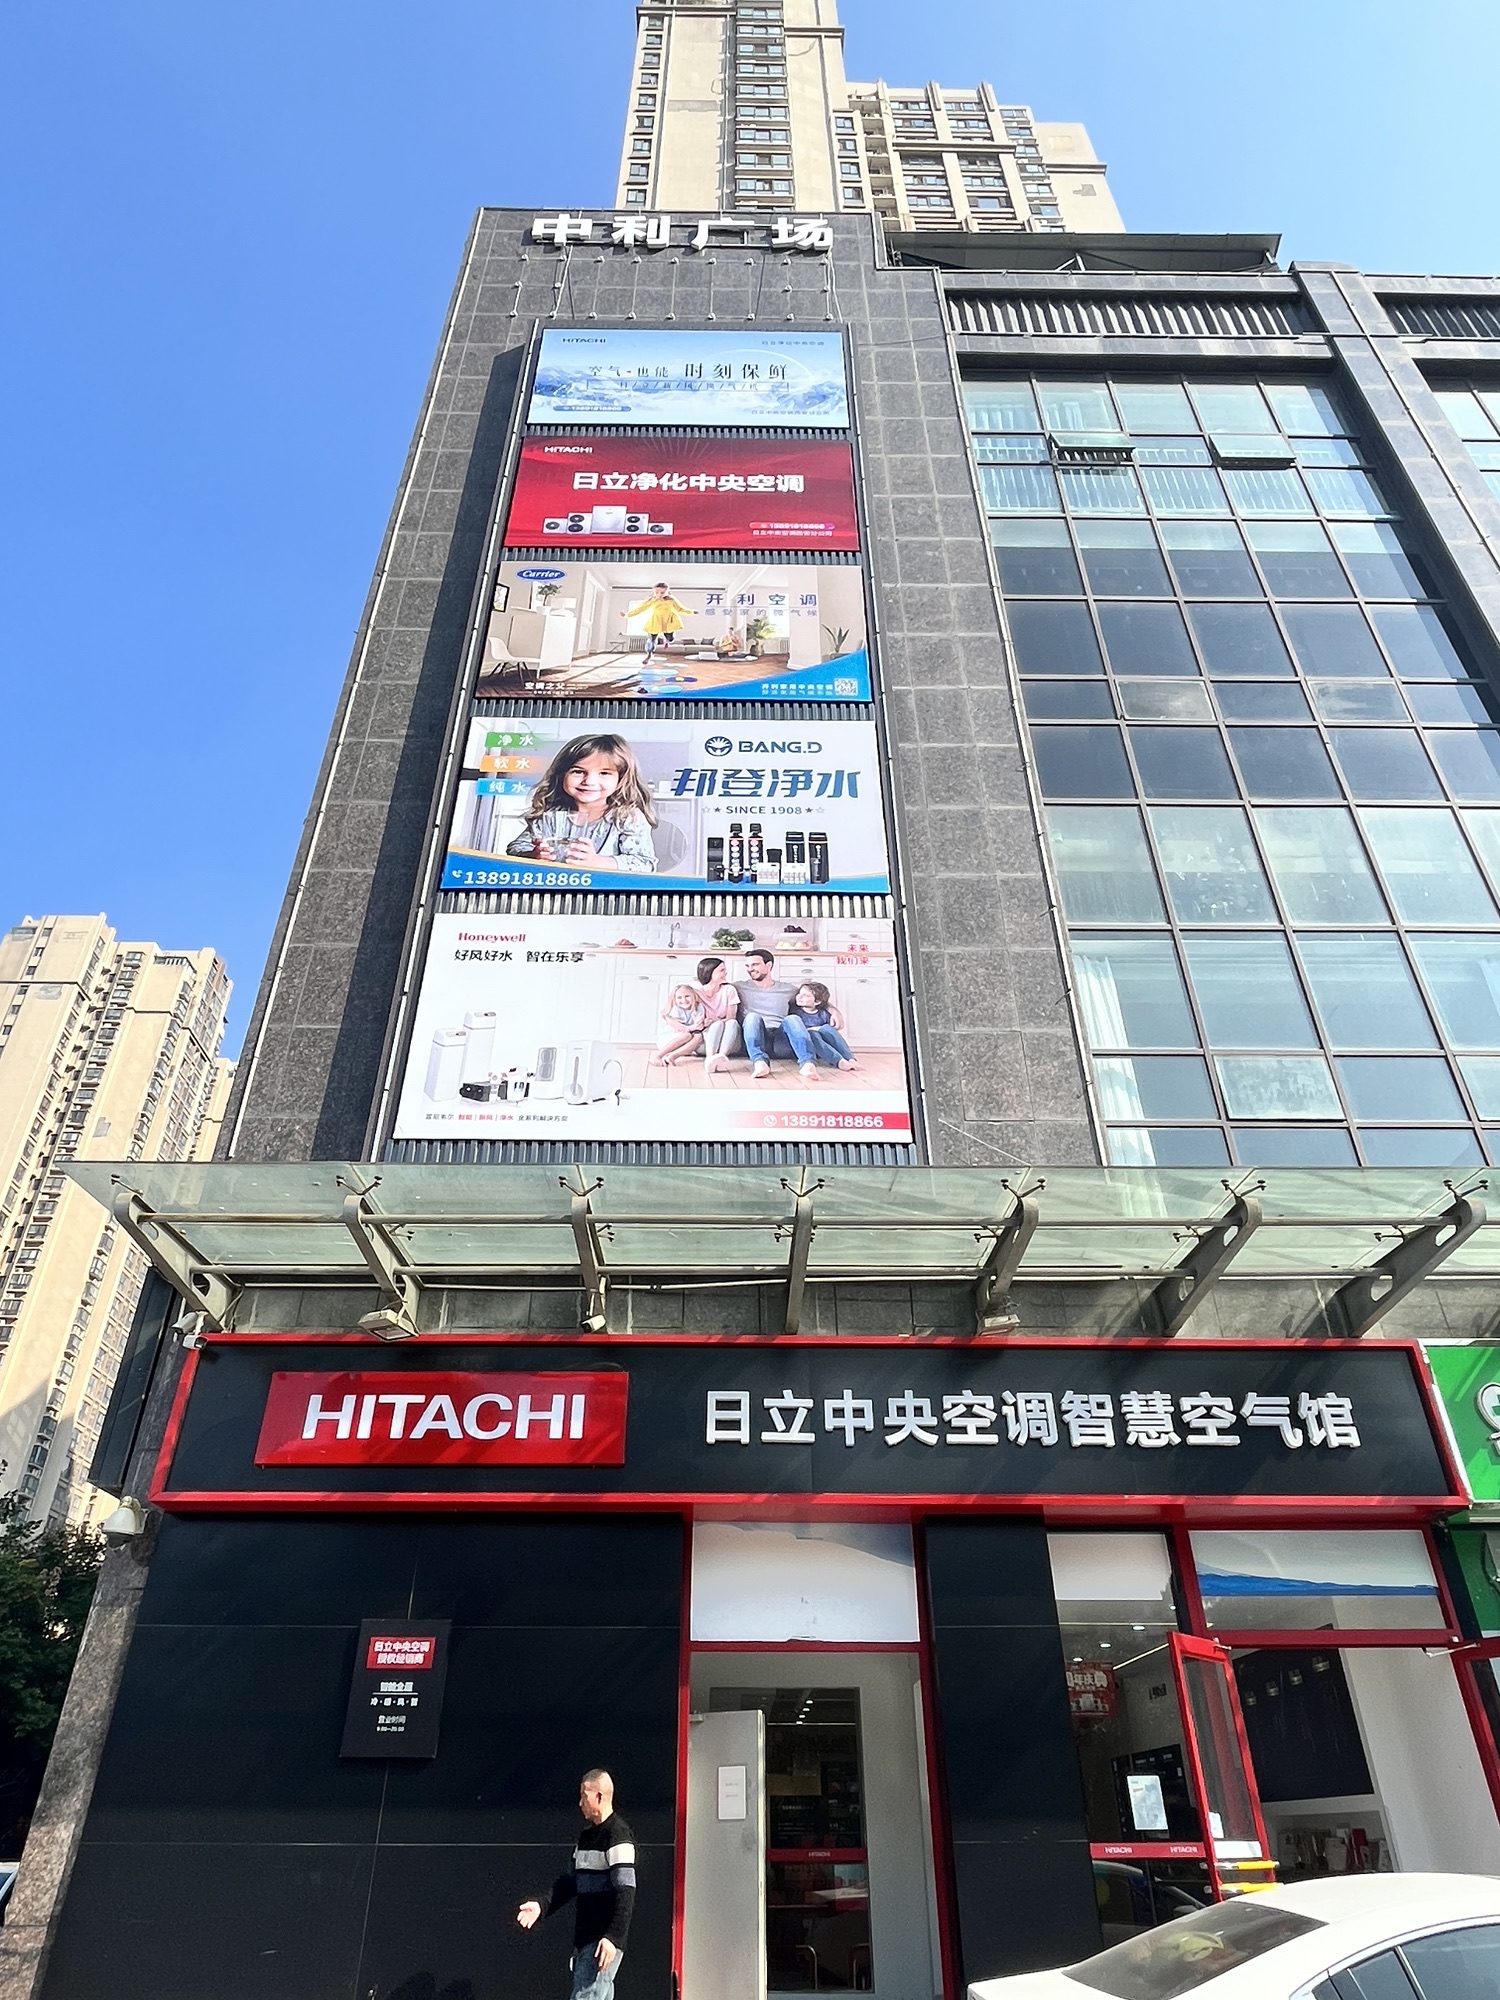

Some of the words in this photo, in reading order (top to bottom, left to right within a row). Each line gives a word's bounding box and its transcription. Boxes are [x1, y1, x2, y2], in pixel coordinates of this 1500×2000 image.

[531, 214, 834, 250] 中利广场
[684, 363, 788, 380] 时刻保鲜
[573, 472, 804, 493] 日立净化中央空调
[521, 569, 561, 580] Carrier
[706, 593, 817, 606] 开利空调
[524, 682, 565, 690] 空调之父
[498, 734, 534, 746] 净水
[738, 740, 823, 754] BANG.D
[493, 758, 530, 770] 软水
[489, 781, 526, 792] 纯水
[670, 768, 860, 798] 邦登净水
[726, 804, 766, 815] SINCE
[771, 805, 803, 815] 1908
[463, 871, 592, 887] 13891818866
[458, 932, 527, 943] Honeywell
[847, 943, 870, 952] 未来
[454, 949, 513, 962] 好风好水
[526, 950, 585, 963] 智在乐享
[781, 1114, 884, 1128] 13891818866
[302, 1393, 585, 1440] HITACHI
[704, 1390, 1362, 1449] 日立中央空调智慧空气馆
[374, 1641, 430, 1652] 日立中央空调
